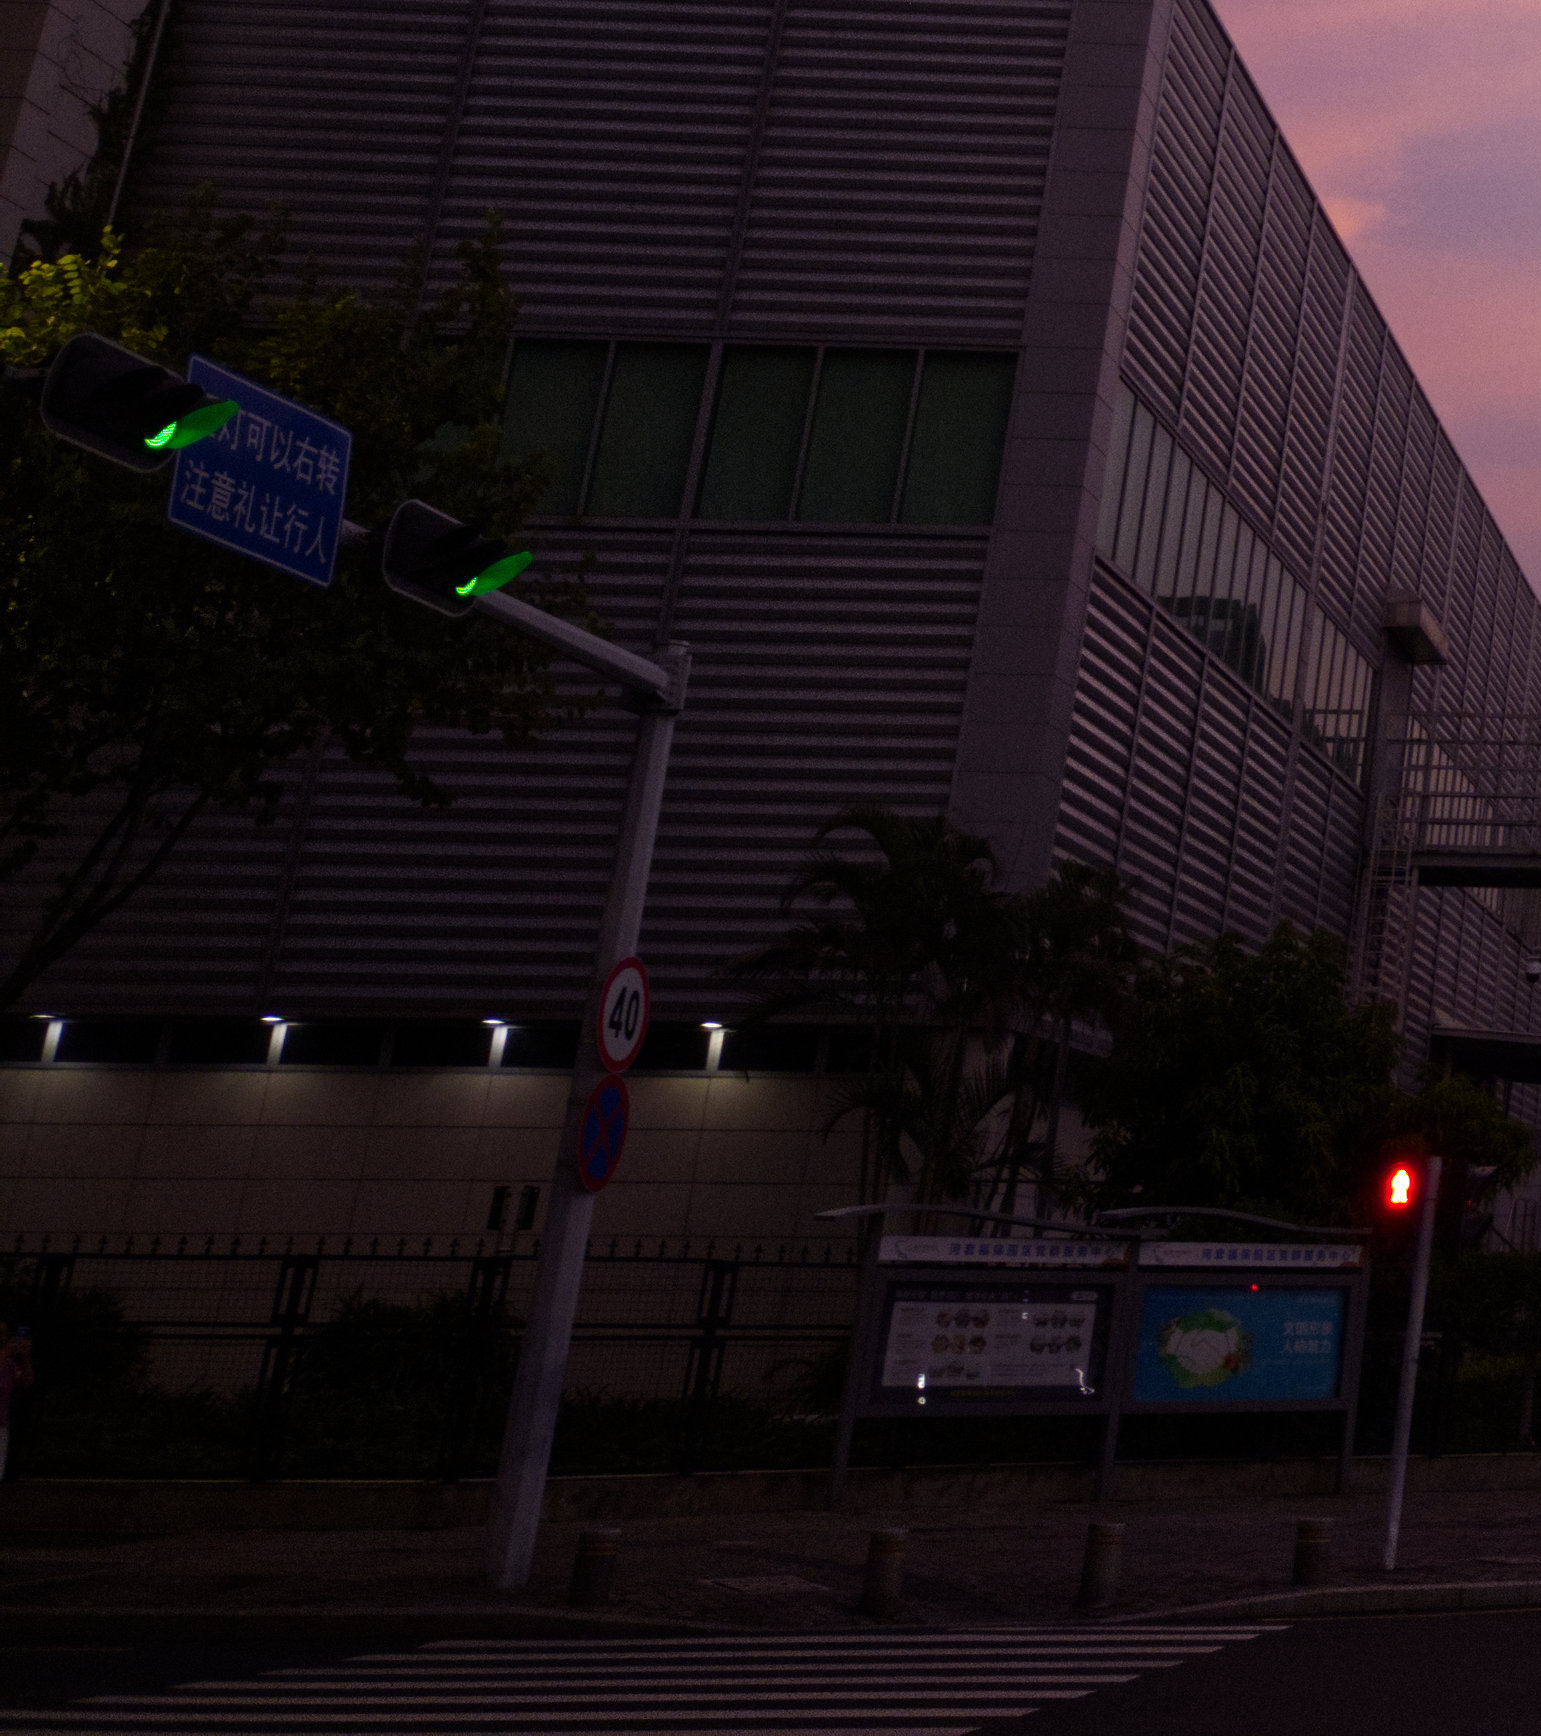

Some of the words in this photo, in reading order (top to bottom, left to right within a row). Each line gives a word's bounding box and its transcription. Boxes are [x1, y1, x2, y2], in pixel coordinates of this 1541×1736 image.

[205, 393, 340, 496] 灯可以右转
[179, 459, 328, 564] 注意礼让行人
[608, 987, 640, 1040] 40
